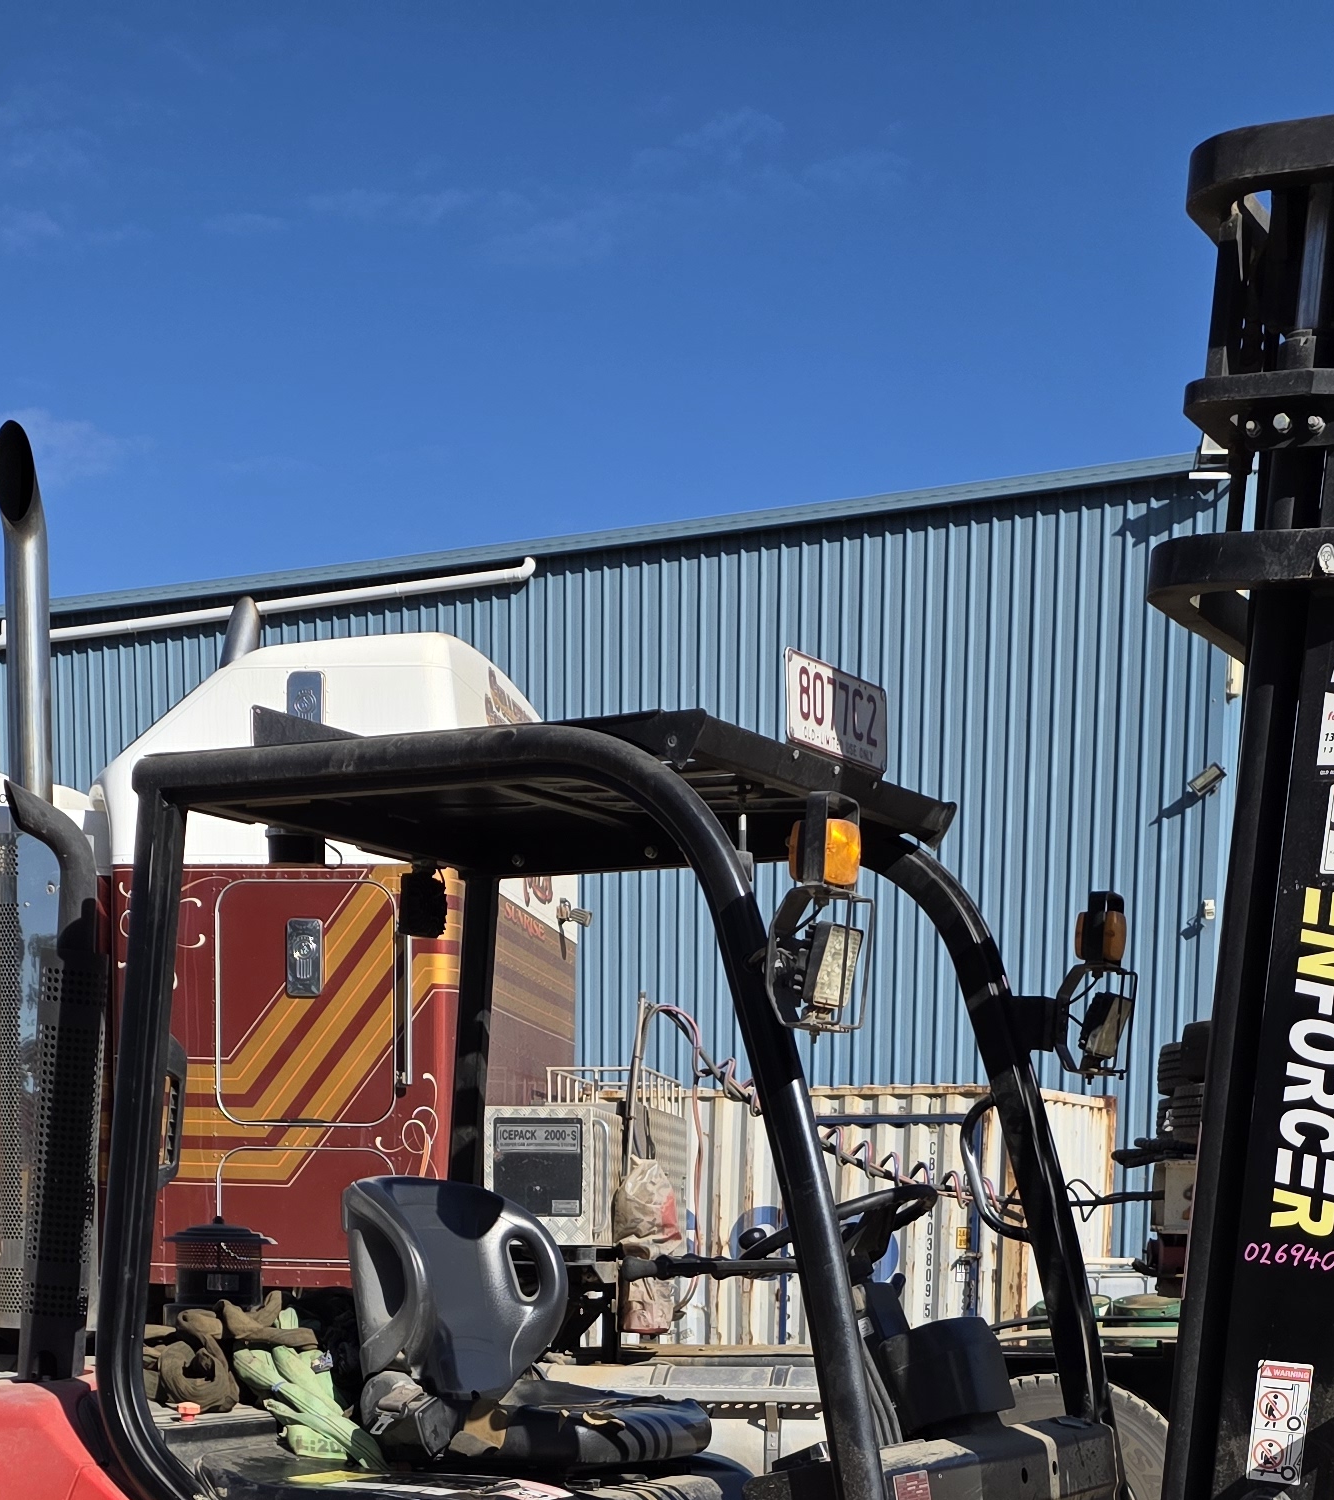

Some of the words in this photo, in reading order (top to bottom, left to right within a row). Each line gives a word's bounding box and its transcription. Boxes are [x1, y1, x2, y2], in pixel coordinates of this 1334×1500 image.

[798, 665, 878, 748] 8077C2
[505, 902, 546, 942] SUNRISE
[499, 1129, 537, 1141] ICEPACK
[544, 1129, 577, 1141] 2000-S
[1273, 1368, 1310, 1379] WARNING
